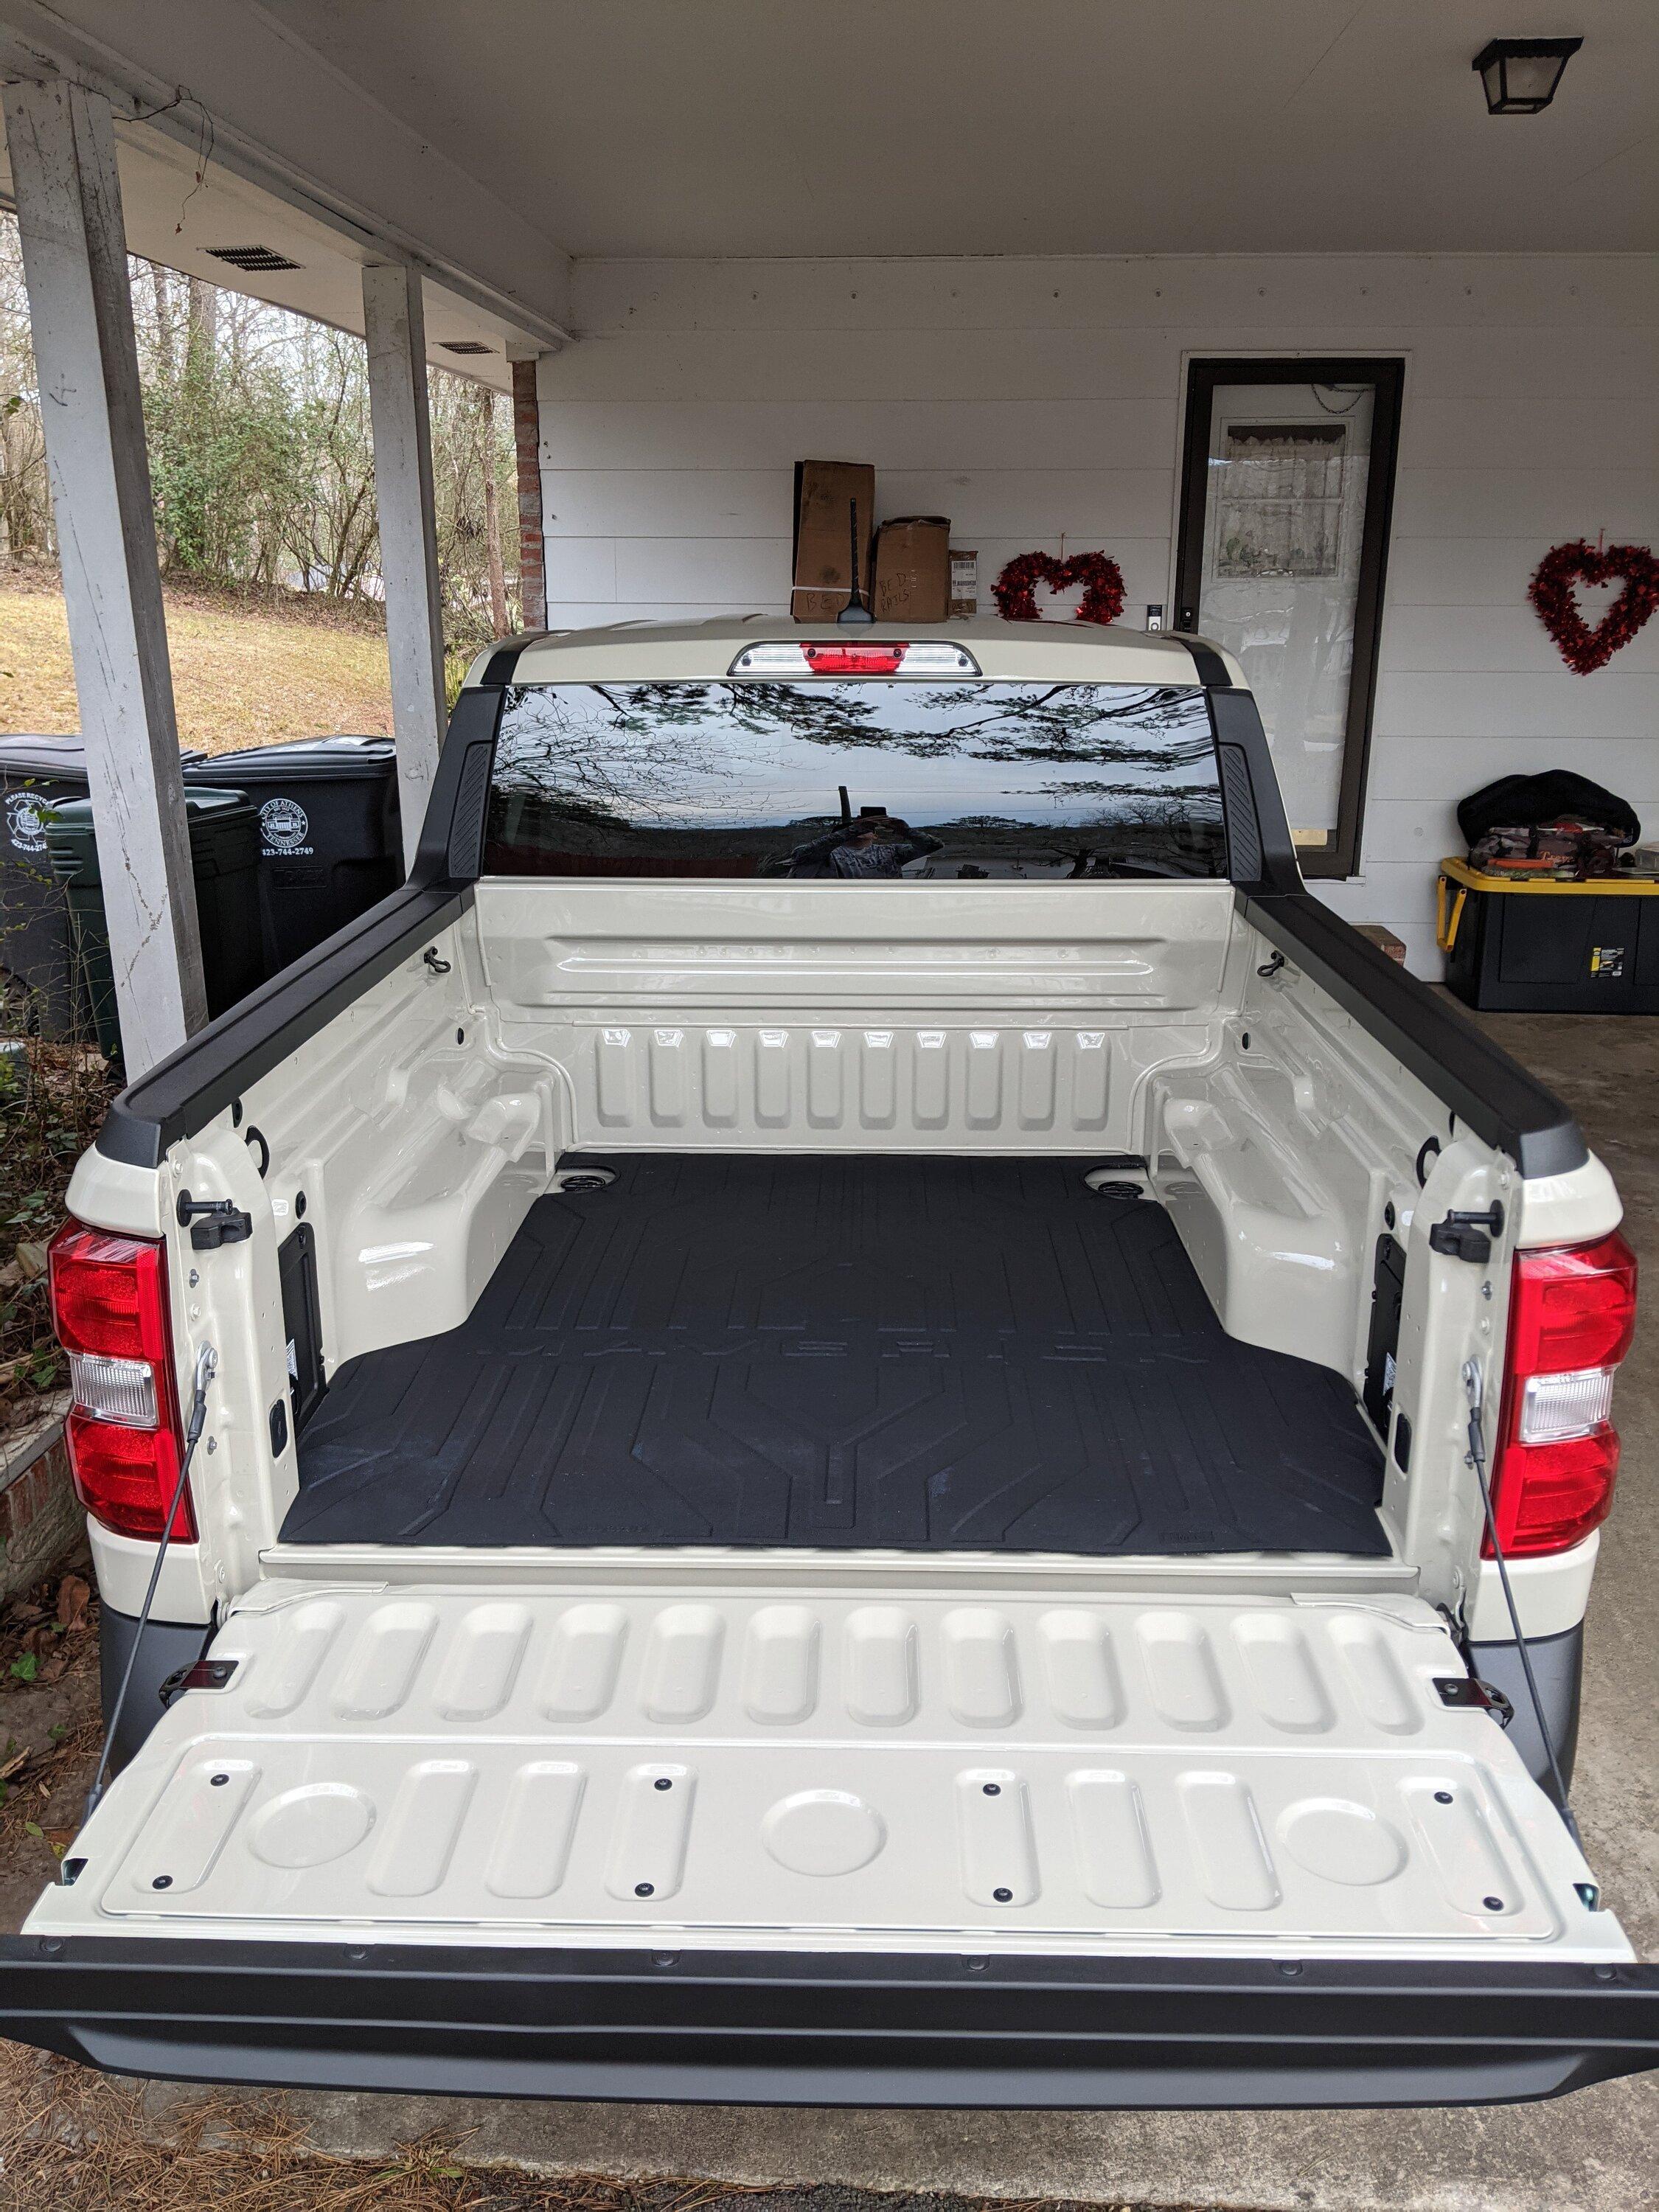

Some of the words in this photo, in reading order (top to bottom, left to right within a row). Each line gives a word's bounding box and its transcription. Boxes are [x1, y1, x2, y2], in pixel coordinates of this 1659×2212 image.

[805, 592, 846, 614] BED
[4, 792, 27, 805] PLEASE
[27, 792, 48, 805] RECYC
[261, 805, 271, 820] CITY
[280, 800, 305, 818] ATHENS
[11, 839, 49, 852] 423-744-274
[266, 832, 305, 846] TENNESSEE
[262, 846, 314, 856] 423-744-2749
